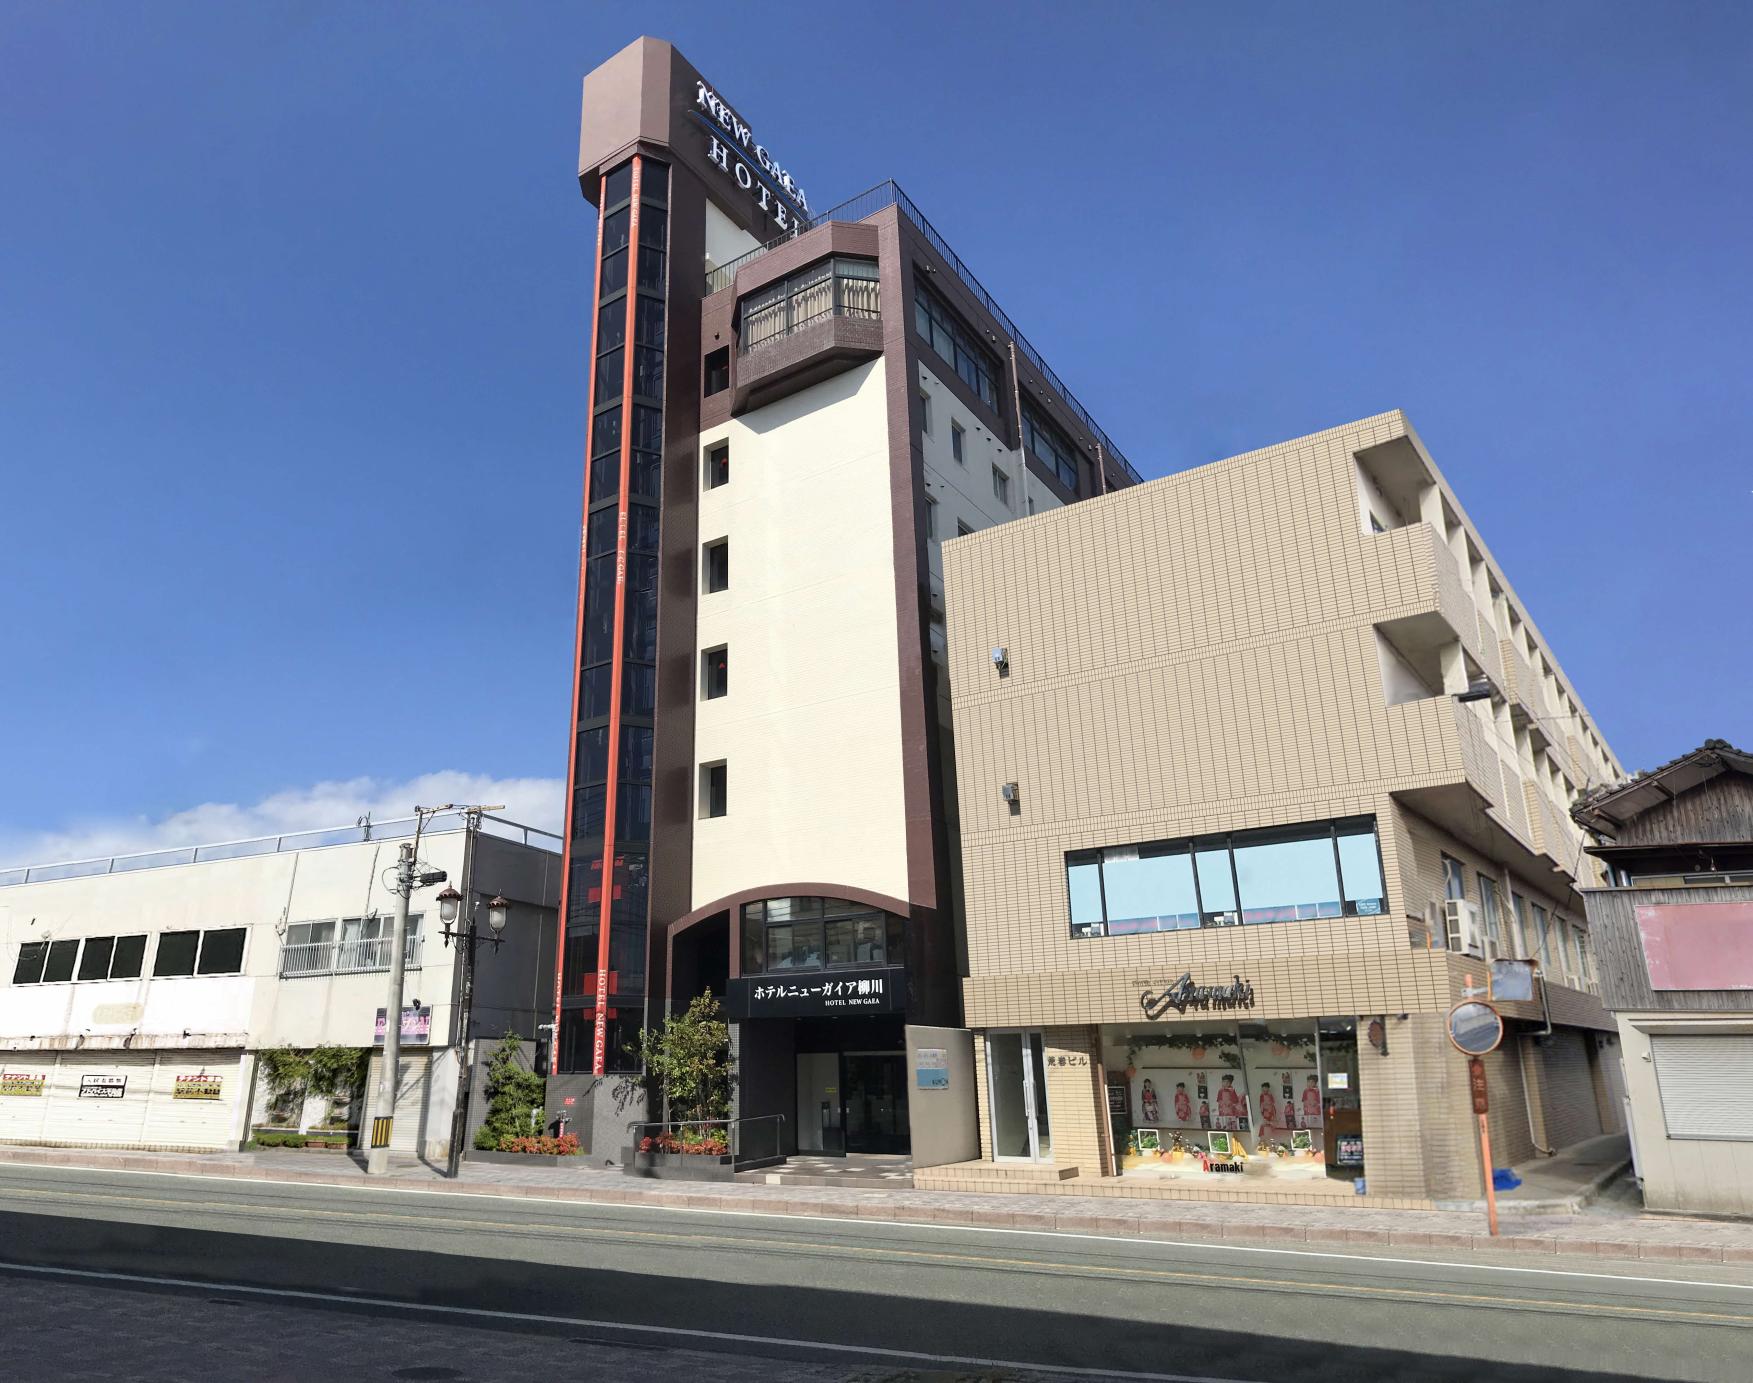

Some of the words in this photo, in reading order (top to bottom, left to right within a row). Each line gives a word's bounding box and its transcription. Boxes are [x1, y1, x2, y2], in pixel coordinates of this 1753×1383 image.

[697, 81, 751, 147] NEW
[755, 145, 808, 212] GAEA
[597, 969, 606, 1008] HOTEL
[754, 978, 883, 1000] ホテルニューガイア柳川
[825, 999, 847, 1007] HOTEL
[595, 1012, 605, 1038] NEW
[1203, 1160, 1244, 1173] Aramaki
